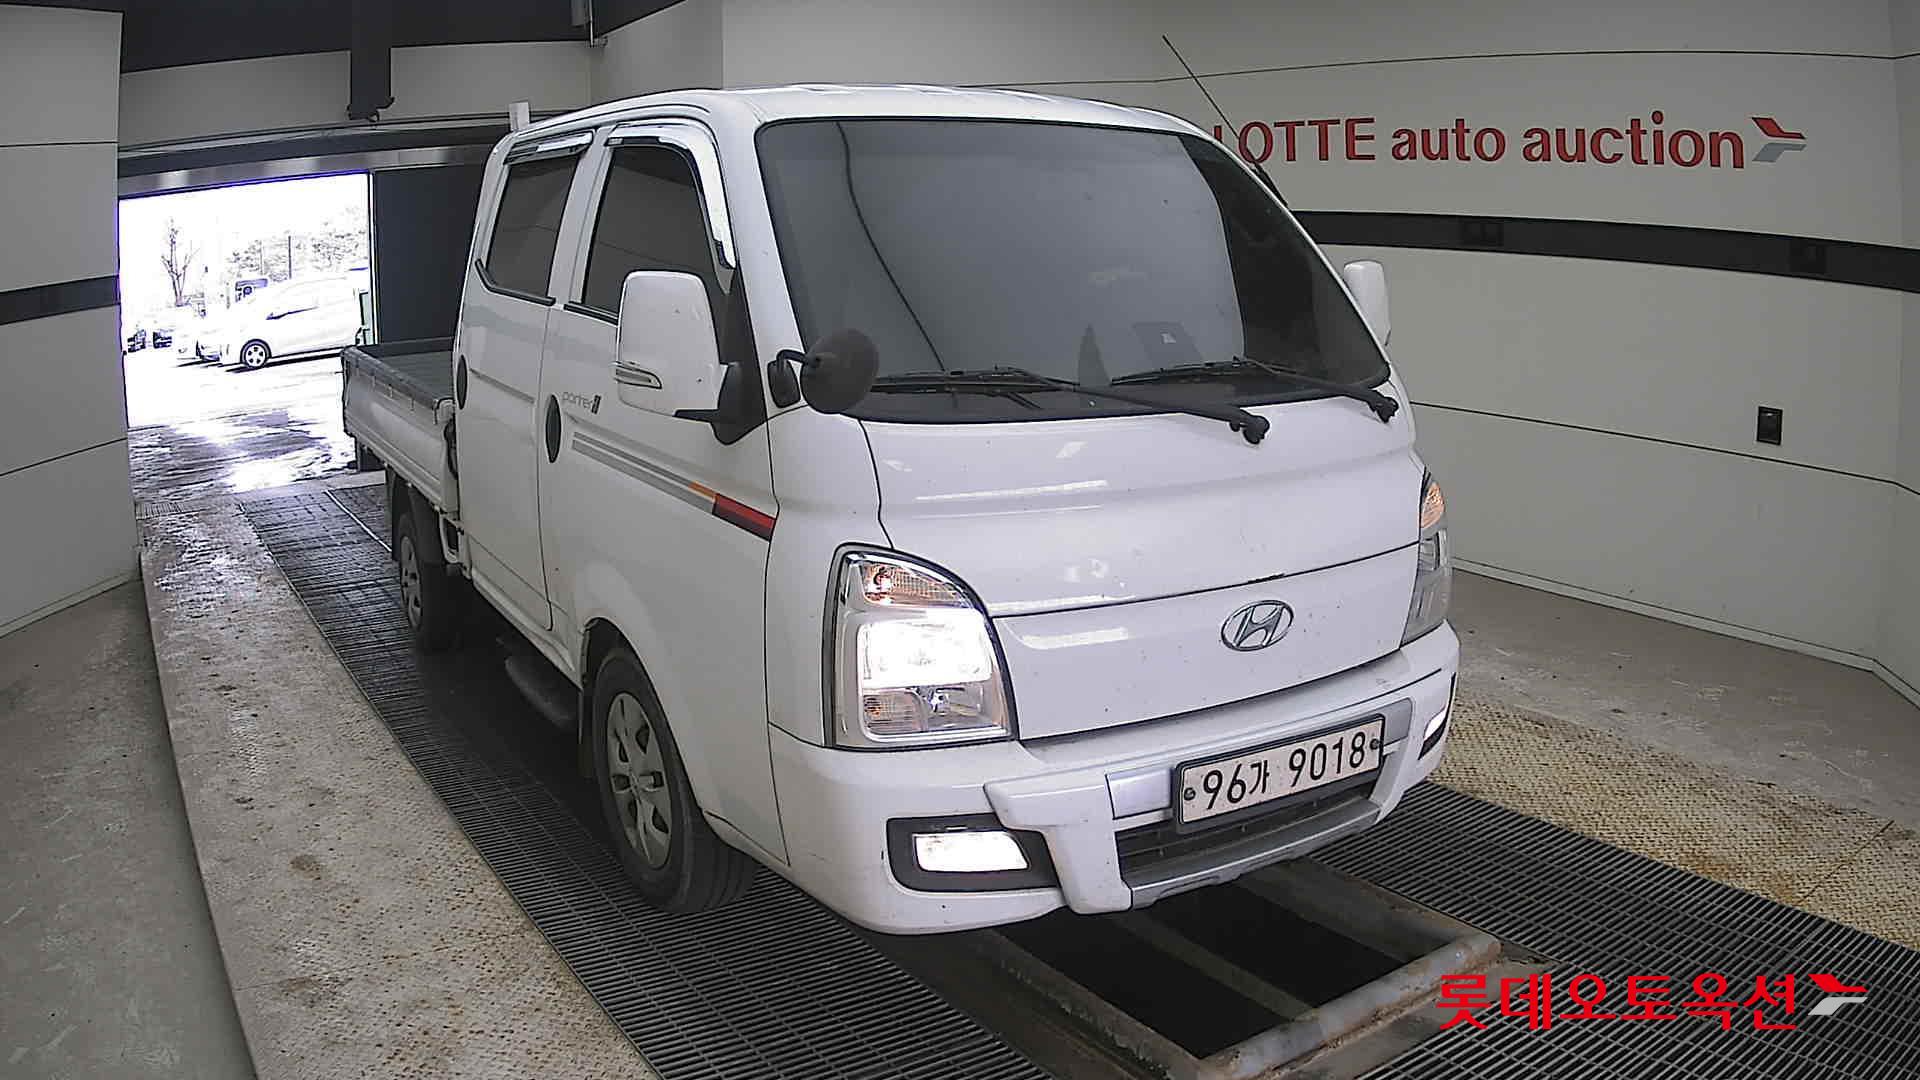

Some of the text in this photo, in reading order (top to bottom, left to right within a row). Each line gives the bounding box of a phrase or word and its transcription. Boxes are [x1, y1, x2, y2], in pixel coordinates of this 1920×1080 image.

[1391, 118, 1506, 163] auto
[1522, 110, 1745, 169] auction
[1202, 731, 1367, 810] 96가 9018
